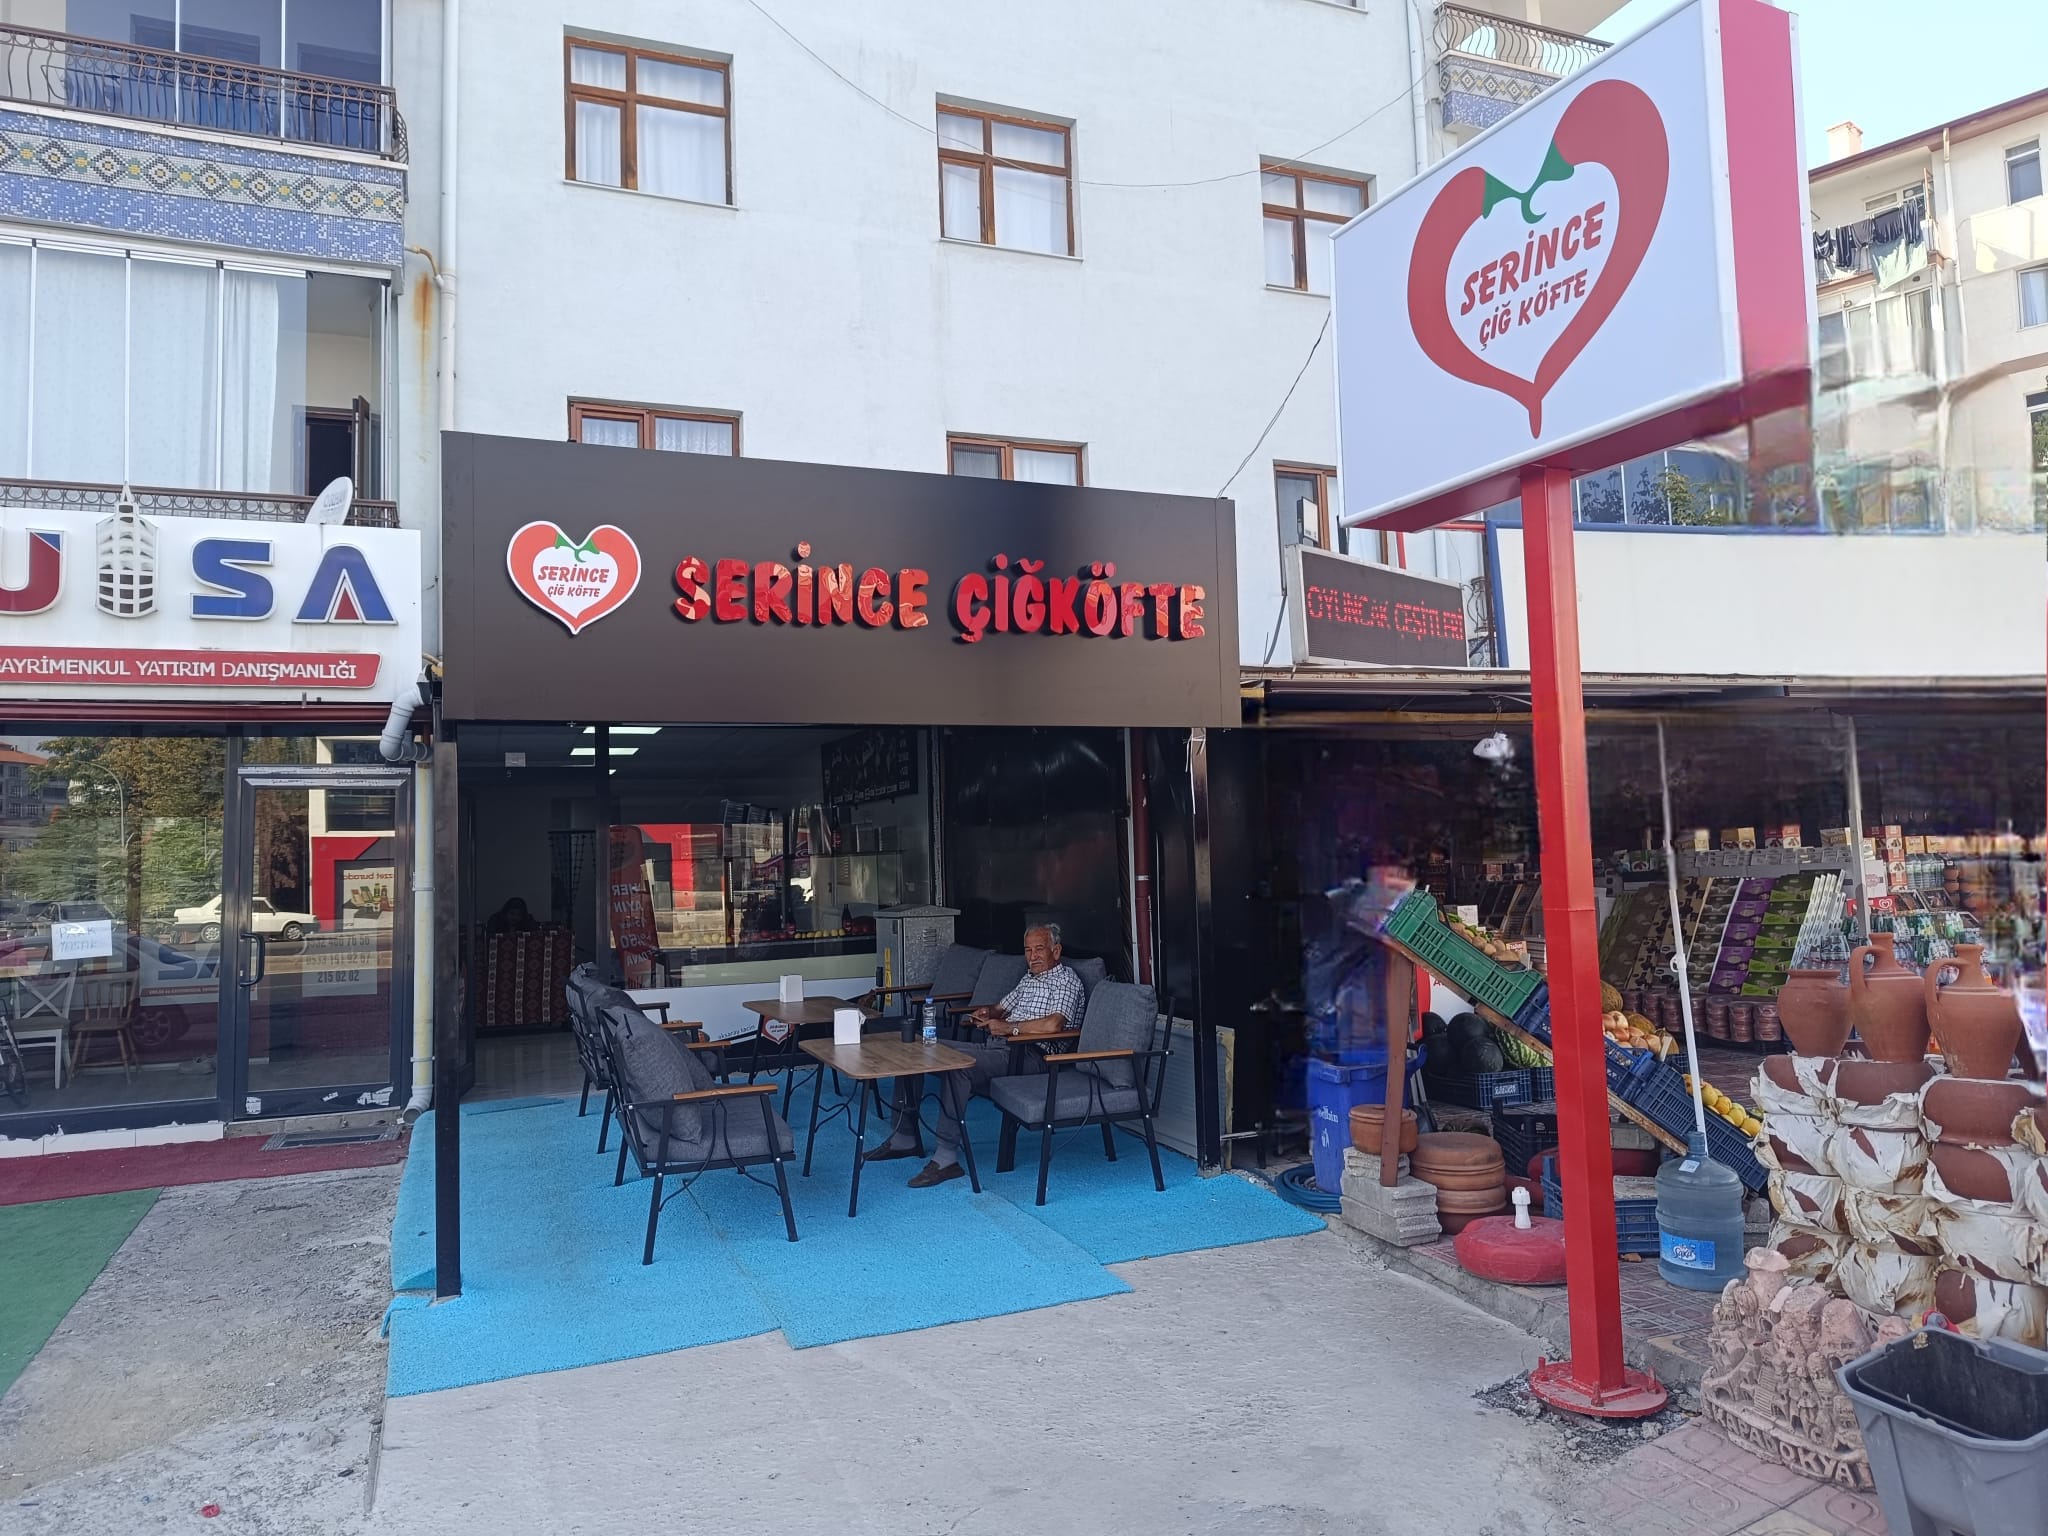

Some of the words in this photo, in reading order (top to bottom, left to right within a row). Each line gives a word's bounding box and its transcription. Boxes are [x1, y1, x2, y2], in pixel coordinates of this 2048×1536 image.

[1460, 201, 1606, 316] SERİNCE
[1478, 300, 1511, 352] ÇİĞ
[1517, 268, 1588, 327] KÖFTE
[537, 563, 610, 584] SERİNCE
[547, 583, 565, 598] ÇİĞ
[567, 585, 600, 598] KÖFTE
[674, 540, 929, 628] SERİNCE
[954, 552, 1206, 643] ÇİĞKÖFTE
[0, 655, 131, 677] AYRİMENKUL
[136, 660, 216, 678] YATIRIM
[221, 661, 358, 683] DANIŞMANLIĞI
